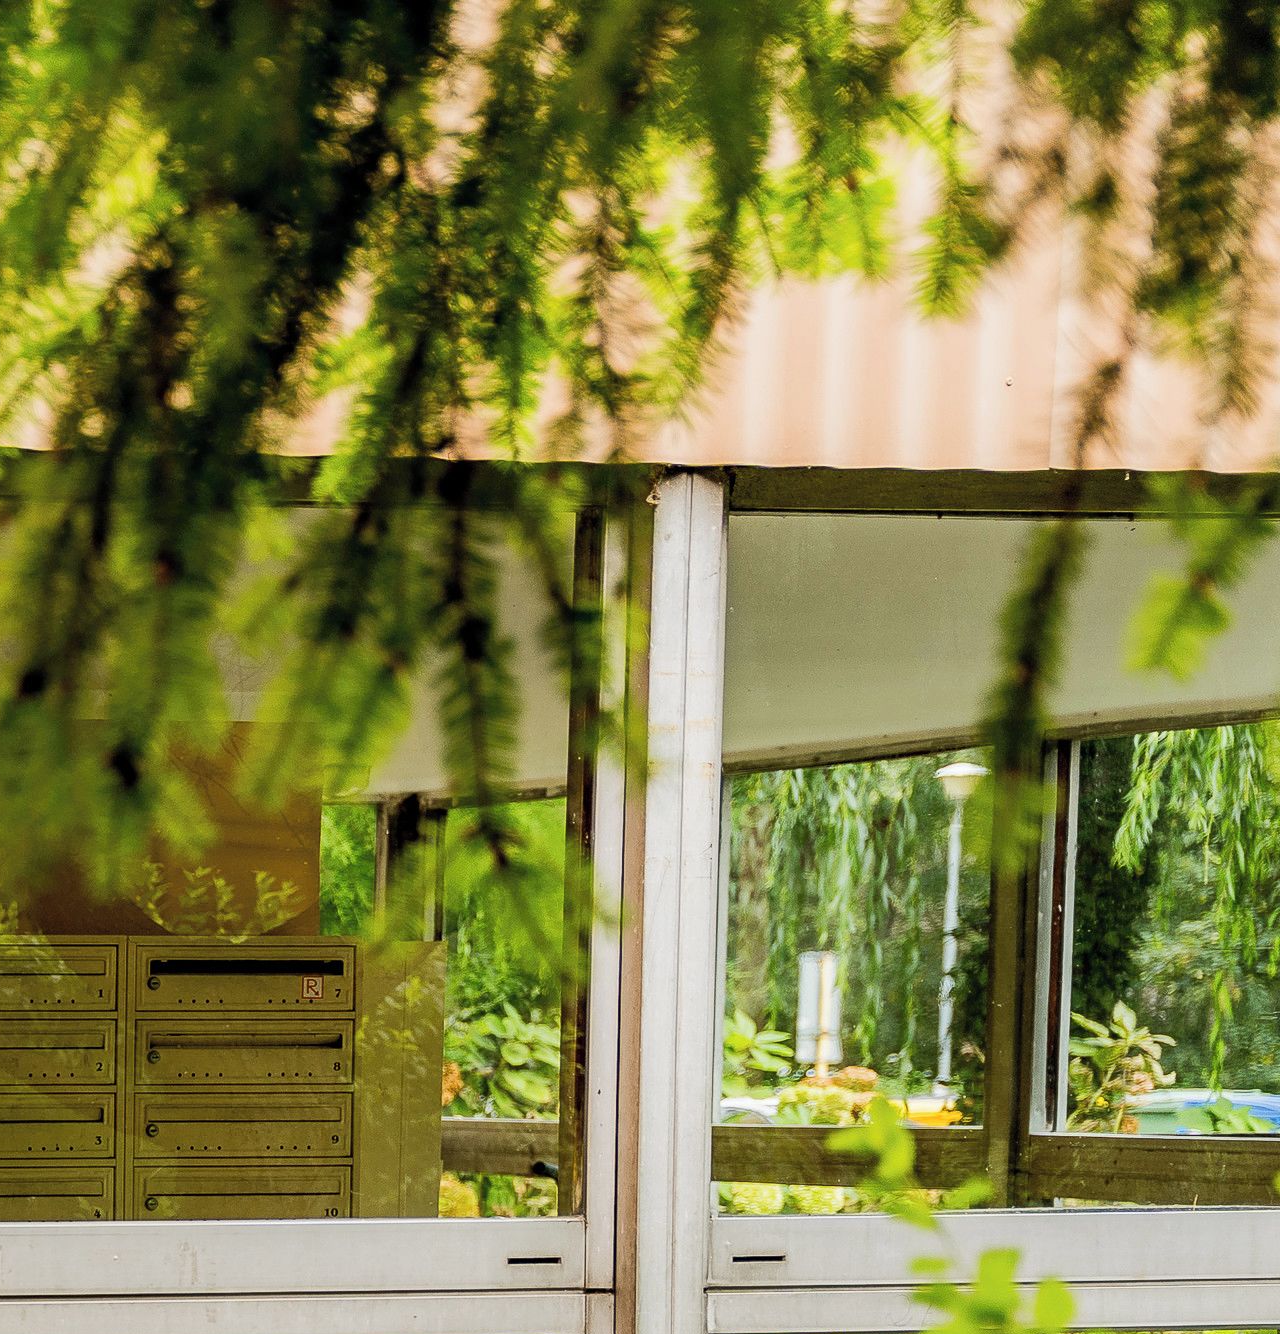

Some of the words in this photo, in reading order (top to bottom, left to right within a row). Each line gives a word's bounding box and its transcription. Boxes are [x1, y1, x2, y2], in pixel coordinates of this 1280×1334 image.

[97, 989, 104, 998] 1
[334, 988, 342, 998] 7
[95, 1062, 103, 1072] 2
[333, 1061, 341, 1072] 8
[94, 1135, 102, 1146] 3
[331, 1134, 340, 1144] 9
[93, 1208, 101, 1219] 4
[324, 1207, 339, 1218] 10
